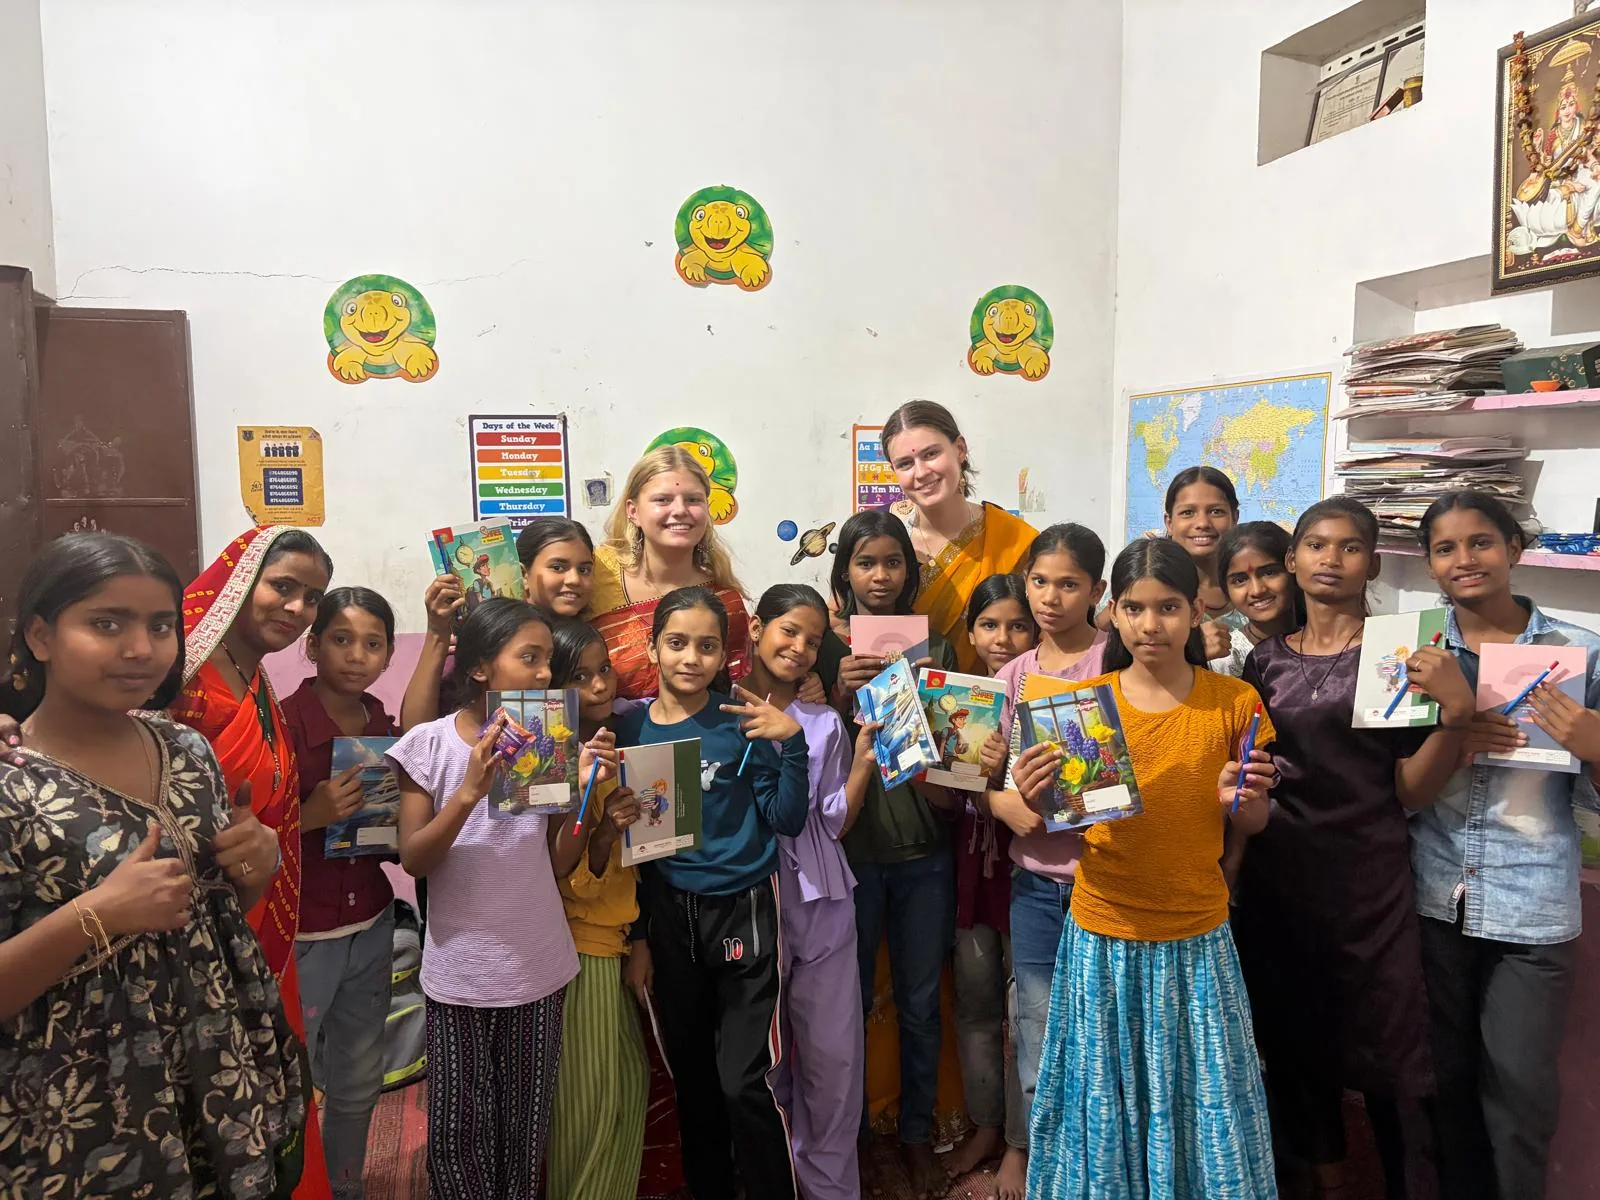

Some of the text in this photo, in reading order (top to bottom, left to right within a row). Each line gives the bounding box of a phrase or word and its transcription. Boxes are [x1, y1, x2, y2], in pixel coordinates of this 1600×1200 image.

[482, 422, 554, 431] Days of the Week
[501, 435, 537, 444] Sunday
[501, 452, 538, 461] Monday
[500, 468, 541, 478] Tuesday
[495, 486, 548, 495] Wednesday
[499, 503, 545, 511] Thursday
[723, 938, 743, 961] 10
